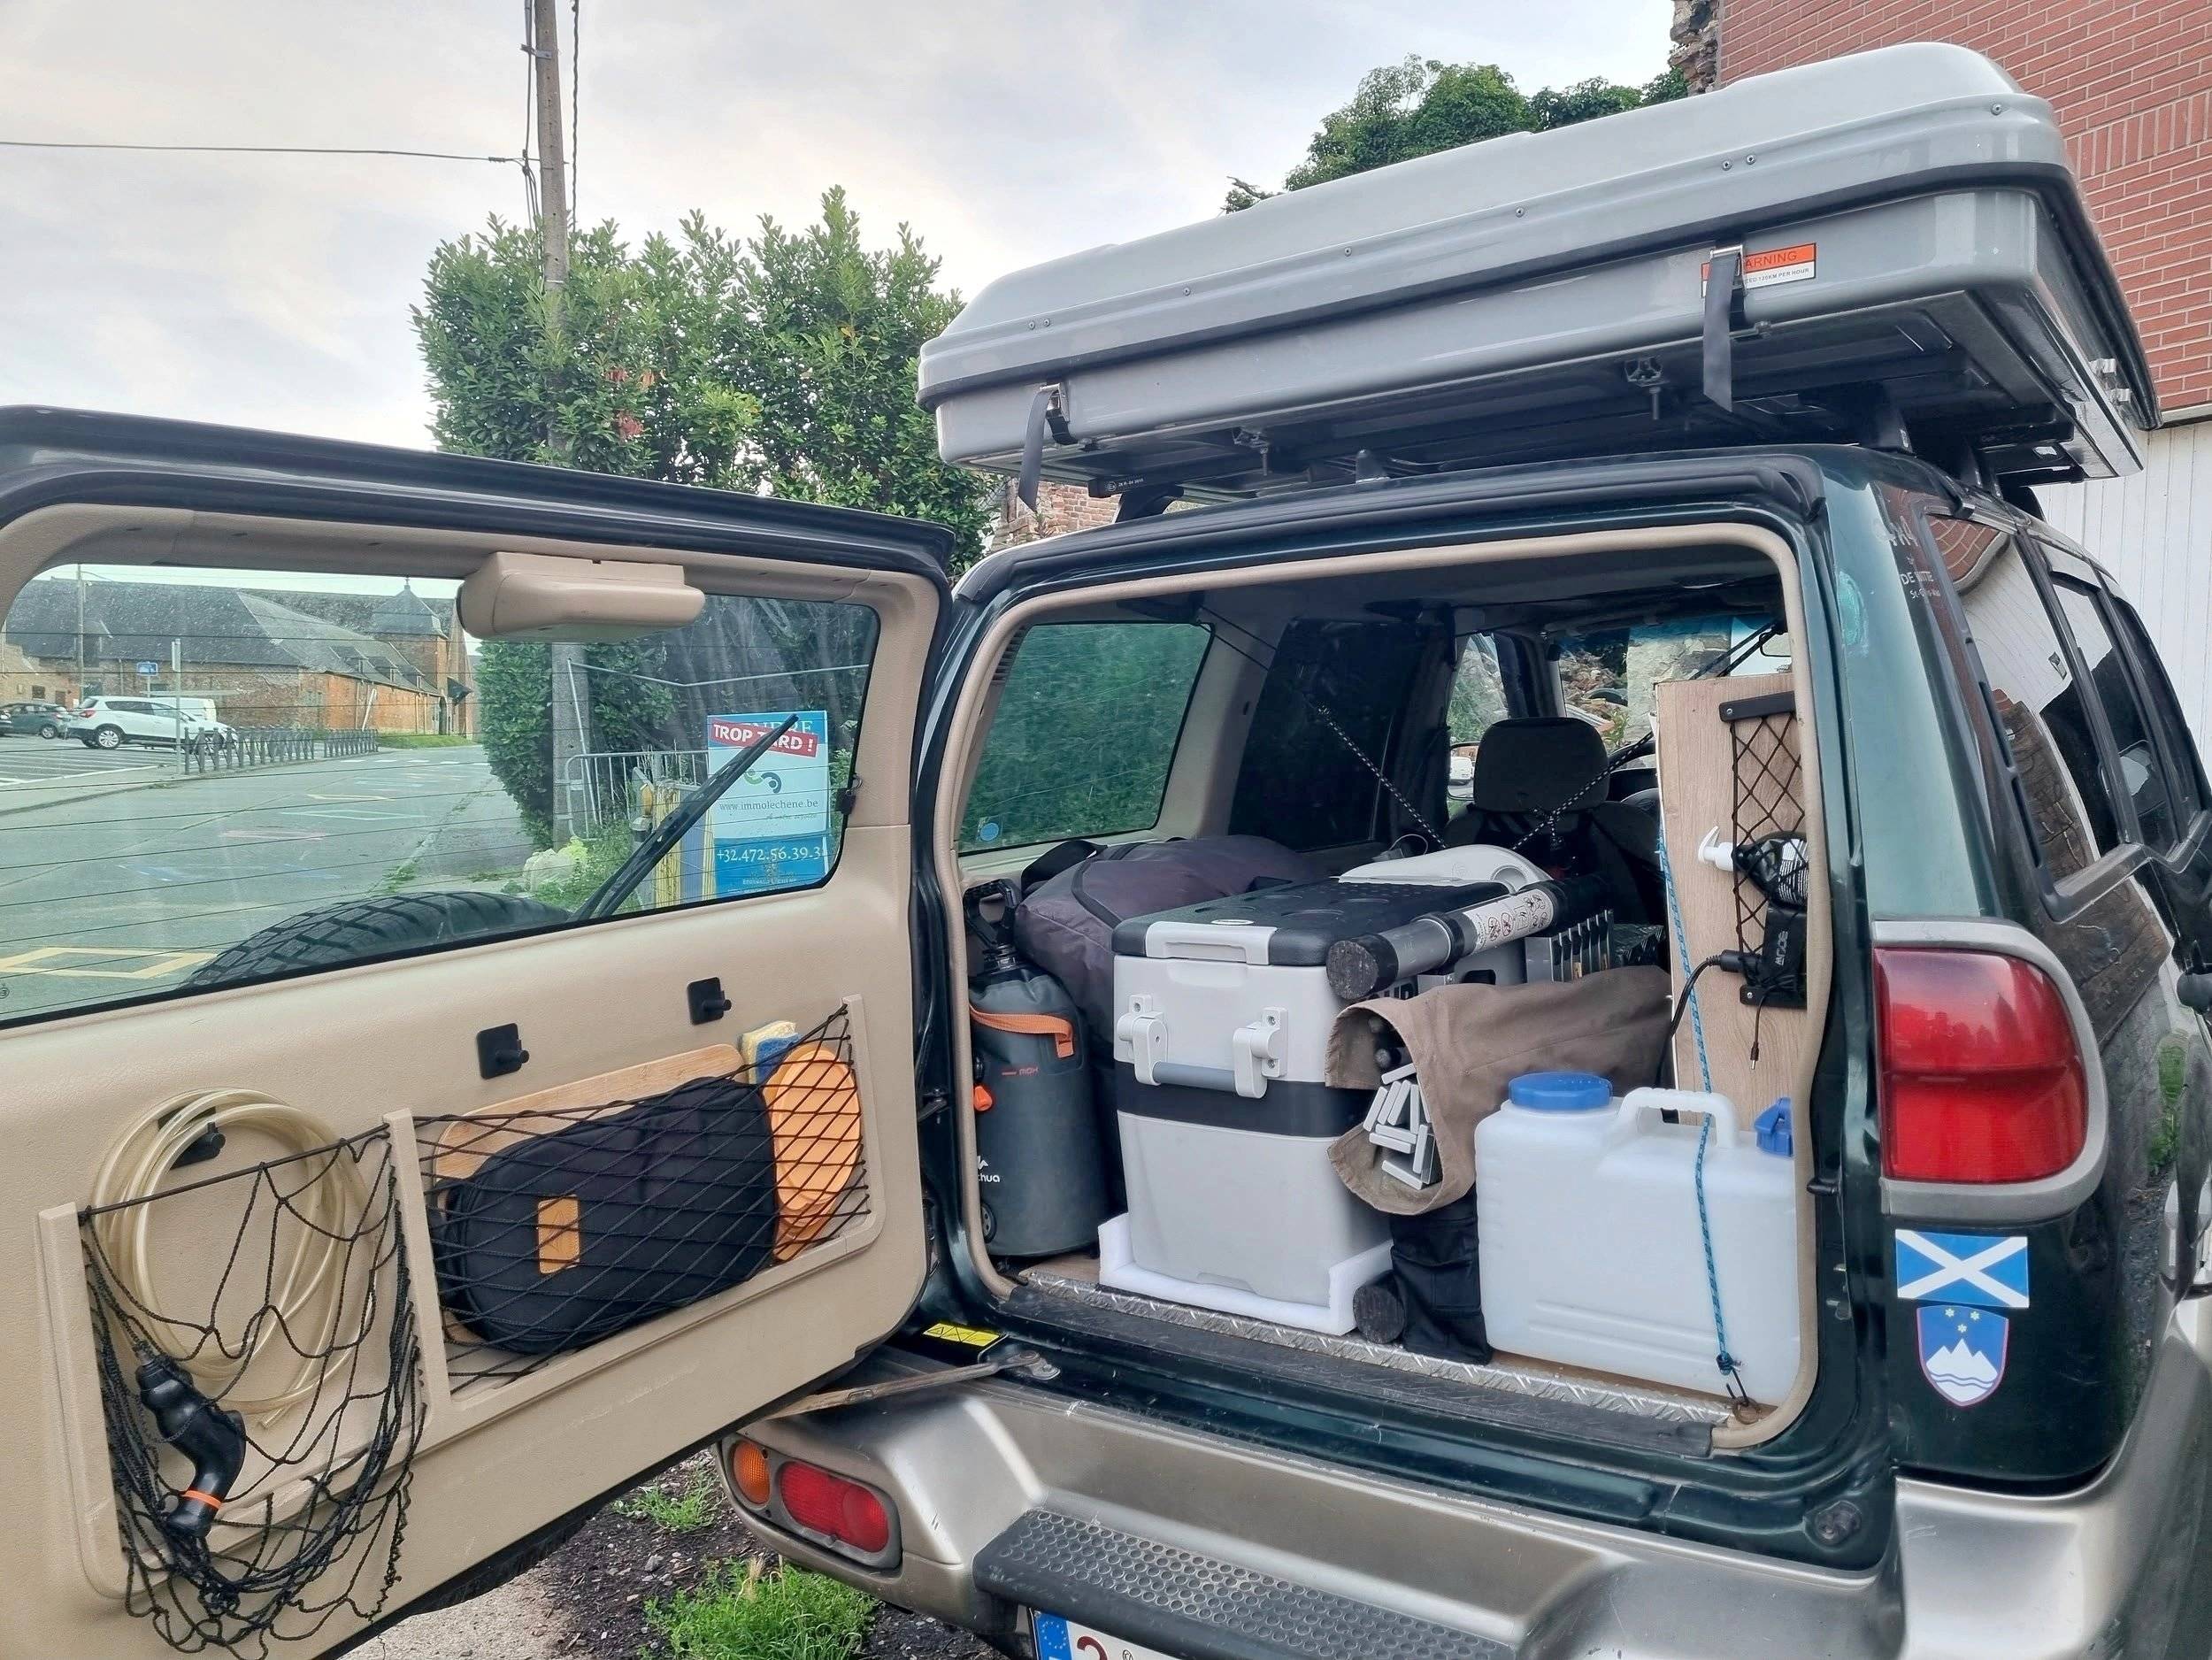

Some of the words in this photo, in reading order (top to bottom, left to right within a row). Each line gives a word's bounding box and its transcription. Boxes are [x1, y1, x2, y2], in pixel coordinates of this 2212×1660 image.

[1746, 251, 1797, 268] ARNING
[713, 724, 753, 742] TROP
[808, 737, 814, 753] !
[717, 846, 822, 863] +32.472.56.39.3
